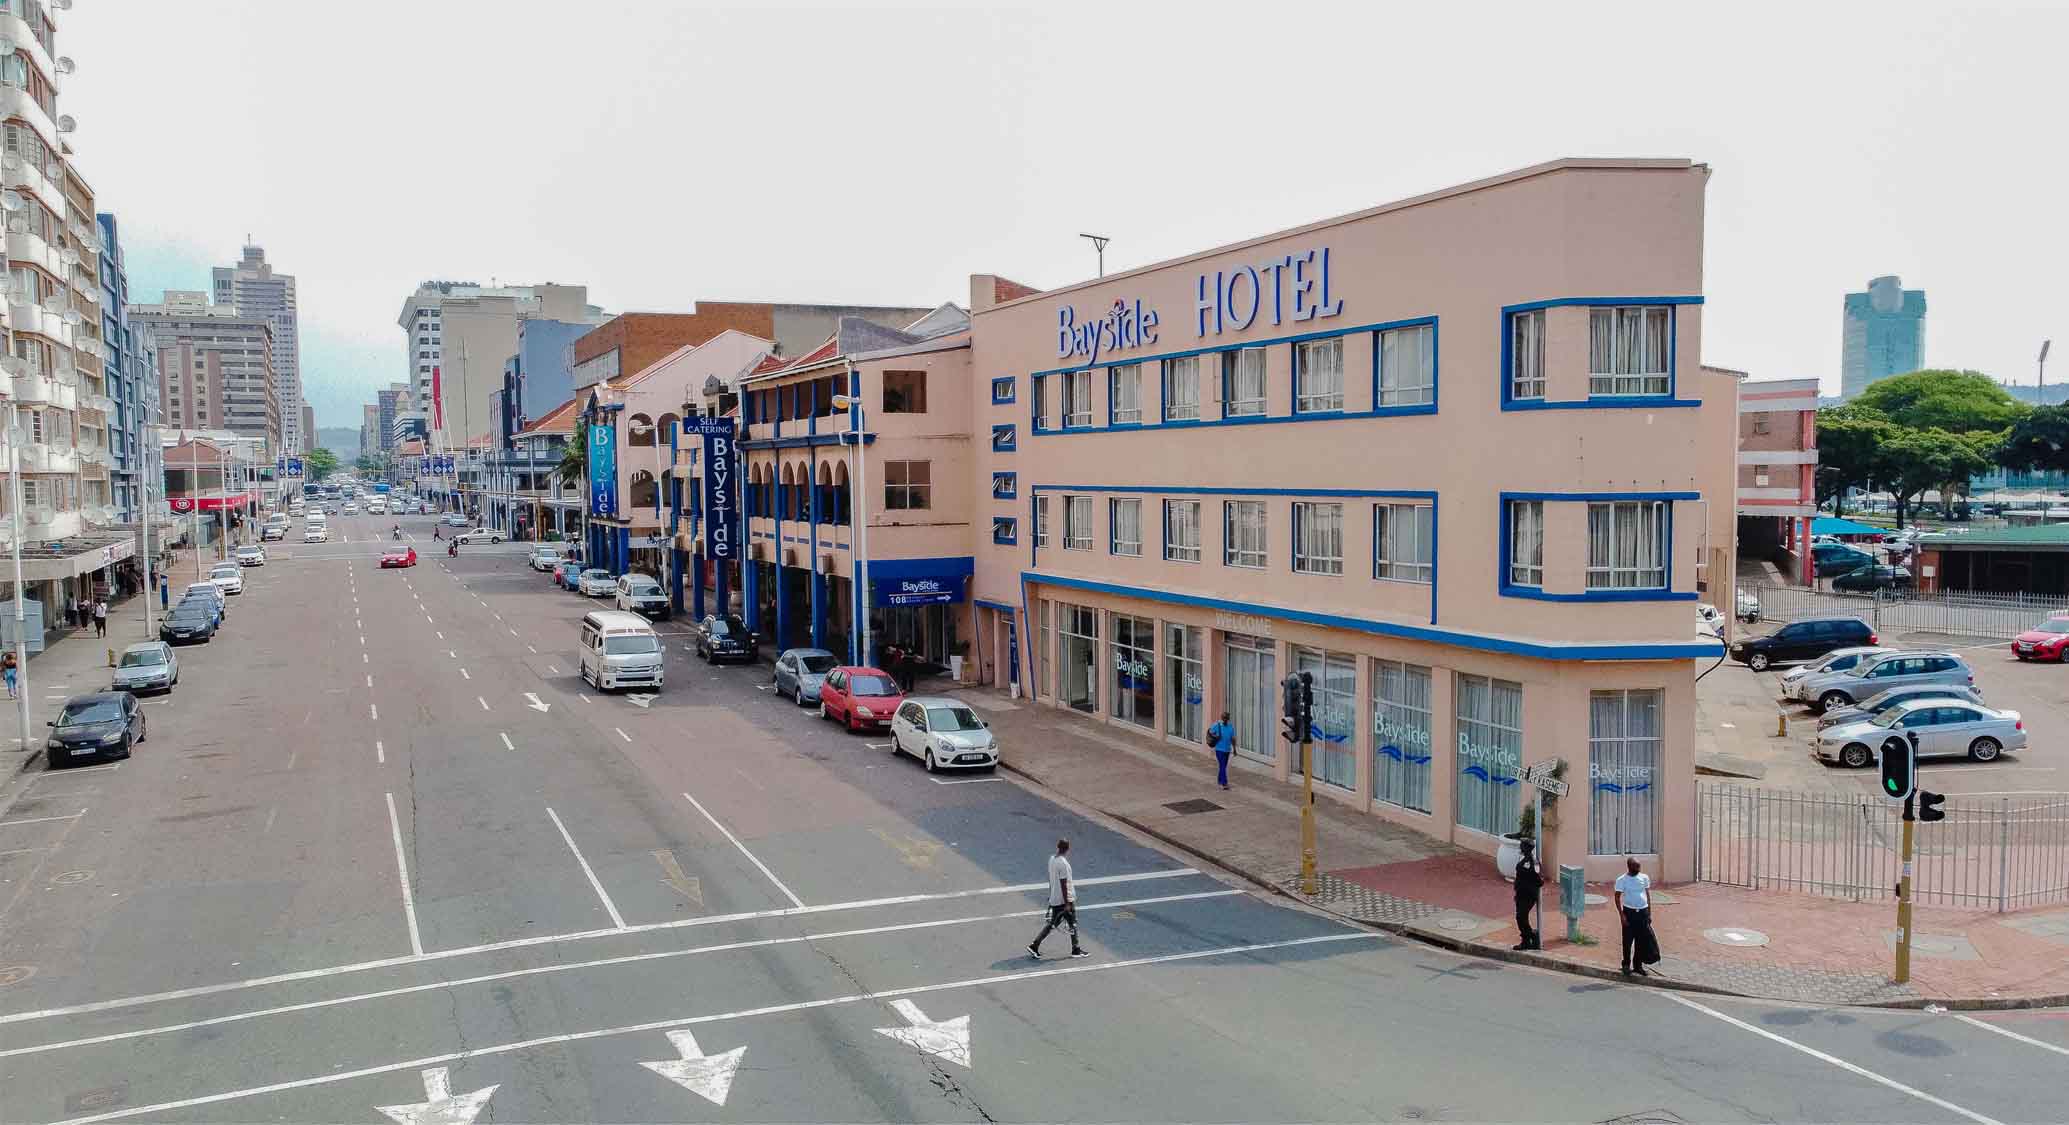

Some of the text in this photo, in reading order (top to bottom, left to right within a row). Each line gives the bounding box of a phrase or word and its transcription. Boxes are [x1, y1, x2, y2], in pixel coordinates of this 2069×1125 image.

[1057, 247, 1343, 366] Bayside HOTEL
[687, 426, 732, 434] CATERING
[595, 427, 609, 513] Bayside
[712, 437, 729, 557] Bayside
[890, 596, 906, 604] 108
[902, 580, 939, 592] Bayside
[1215, 611, 1273, 636] WELCOME
[1374, 711, 1430, 746] Bayside
[1458, 732, 1517, 767] Bayside
[1589, 763, 1649, 782] Bayside
